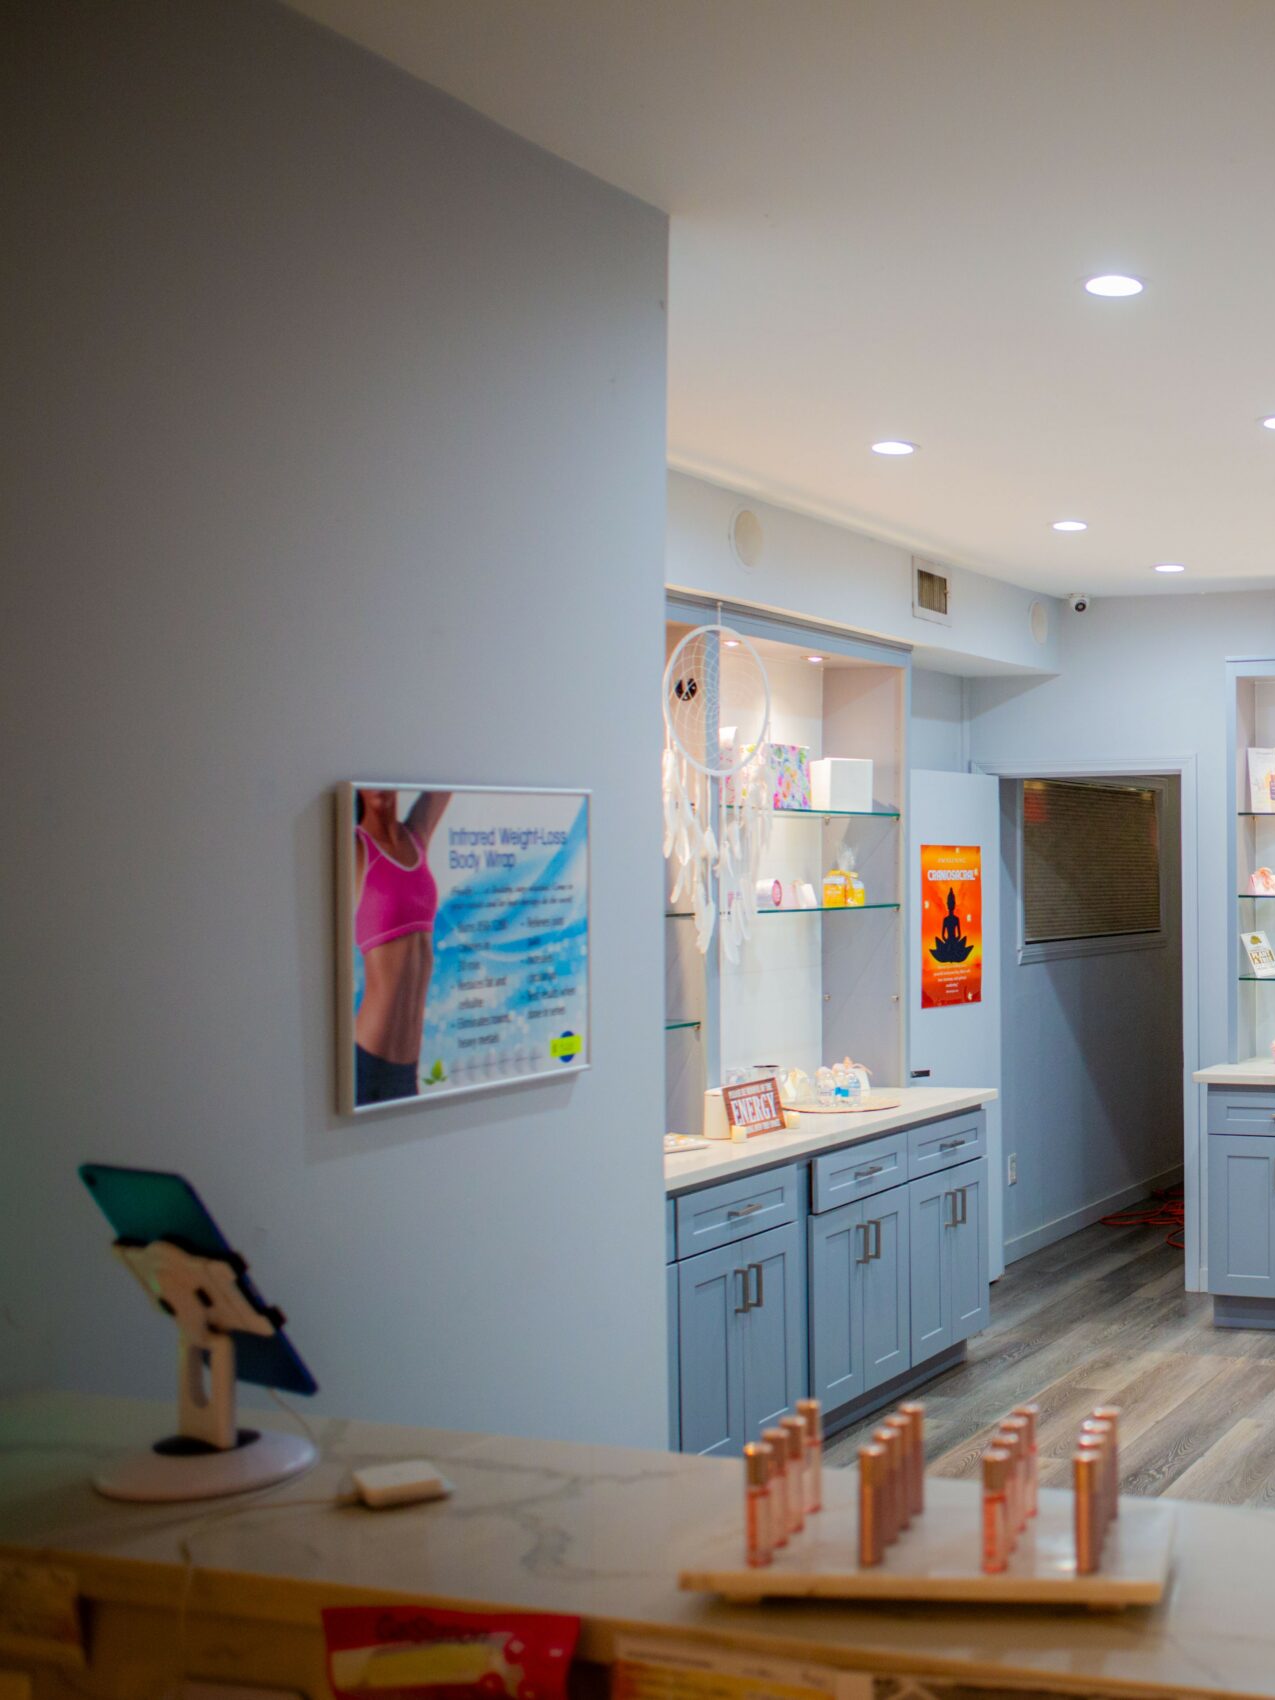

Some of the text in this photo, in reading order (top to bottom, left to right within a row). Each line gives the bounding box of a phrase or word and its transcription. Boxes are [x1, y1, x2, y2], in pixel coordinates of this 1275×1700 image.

[449, 828, 568, 850] Infrared Weight-Loss
[449, 850, 516, 873] Body Wrap
[730, 1091, 778, 1126] ENERGY
